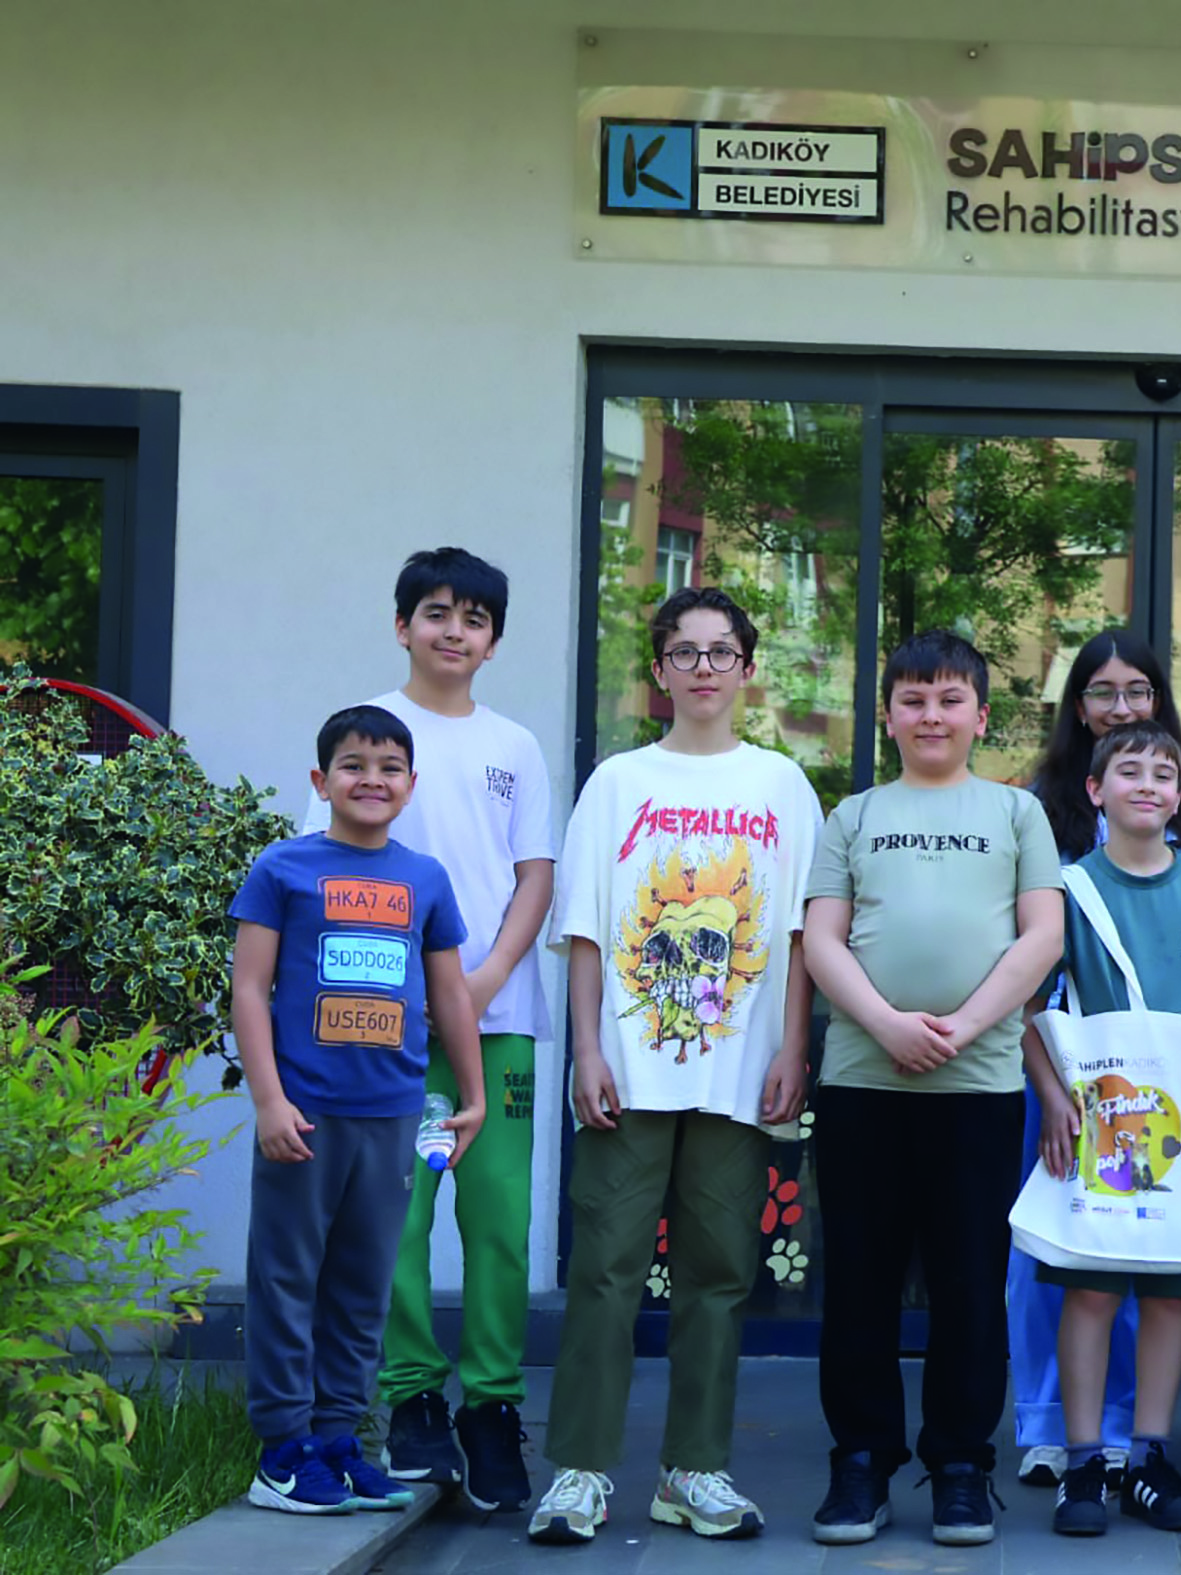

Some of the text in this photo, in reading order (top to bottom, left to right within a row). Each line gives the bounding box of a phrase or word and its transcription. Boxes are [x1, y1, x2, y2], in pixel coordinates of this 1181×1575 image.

[716, 138, 831, 162] KADIKÖY
[617, 797, 779, 864] METALLICA
[870, 833, 991, 854] PROVENCE
[328, 889, 407, 913] HKA7 46
[327, 1010, 397, 1033] USE607
